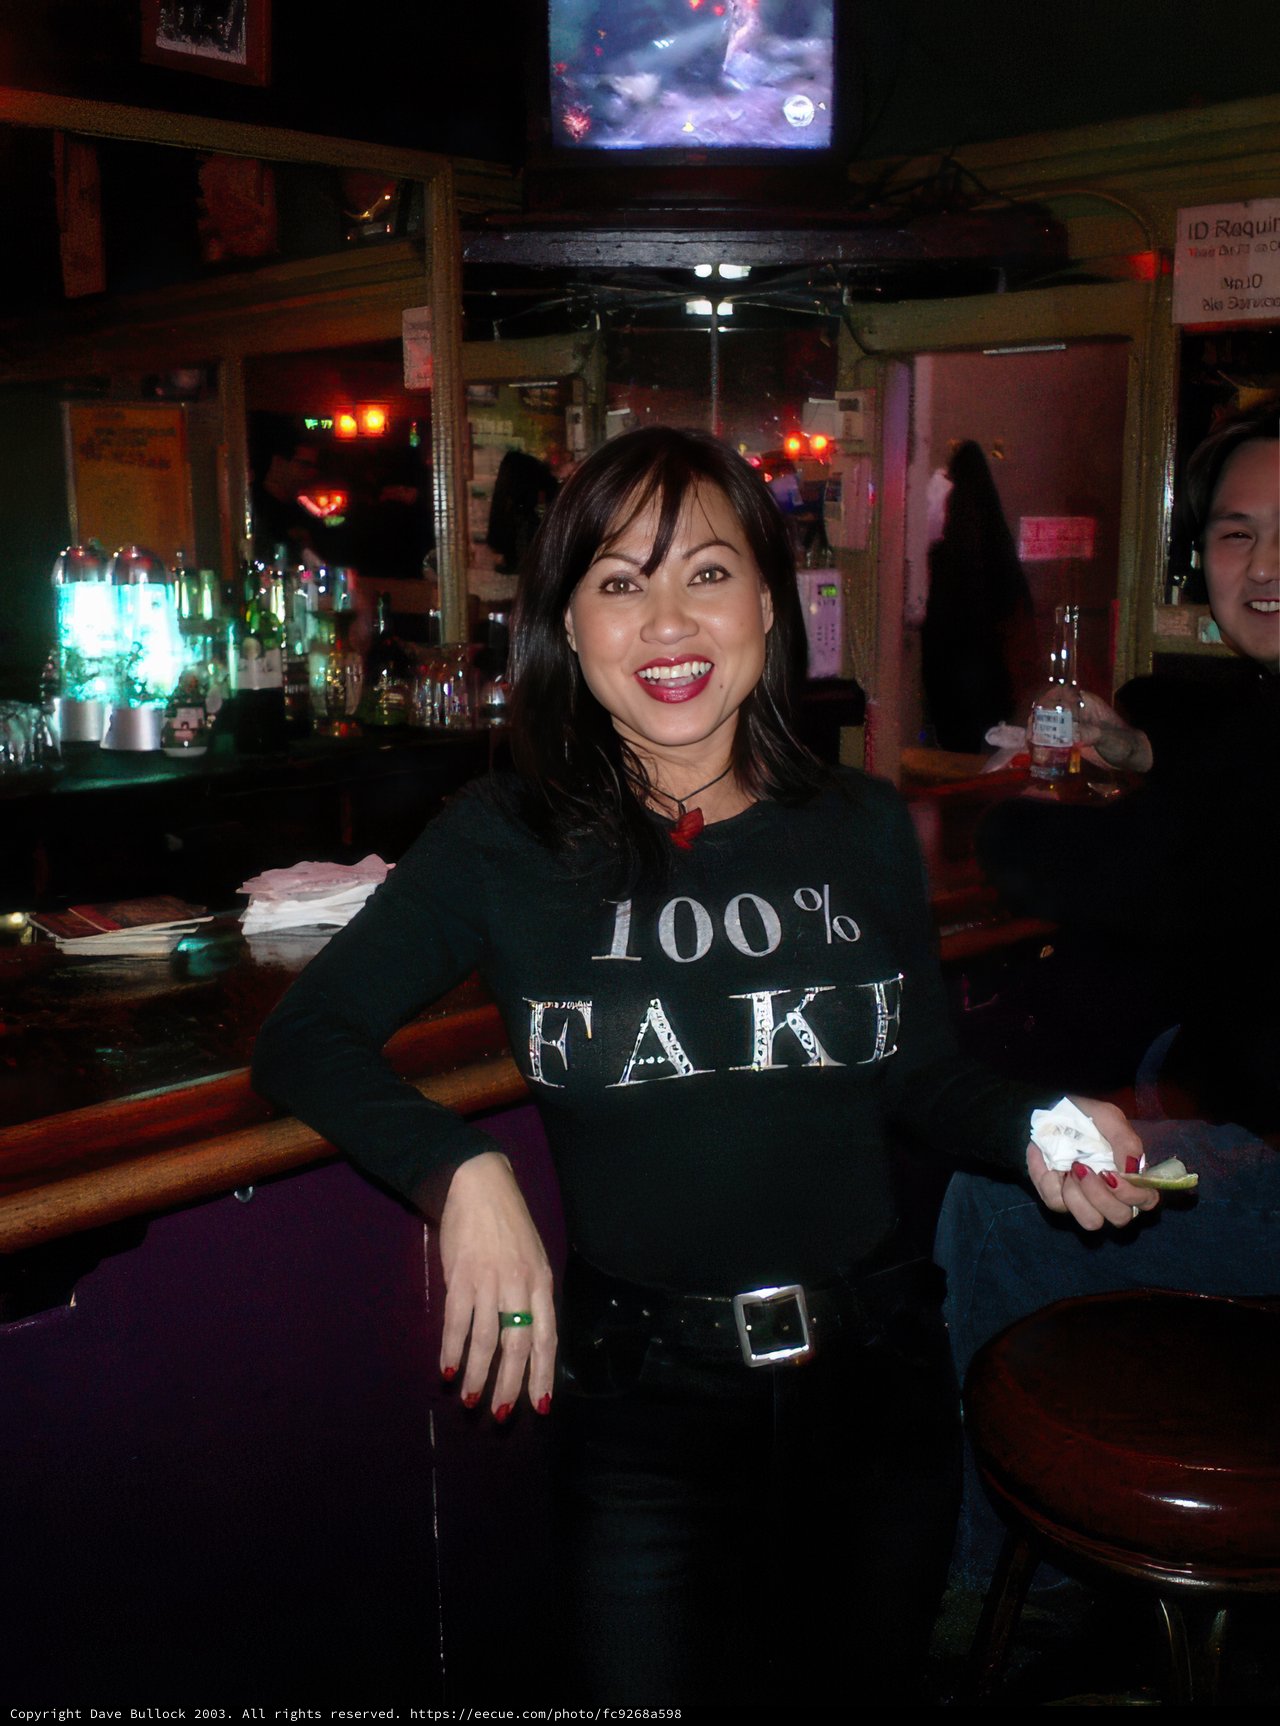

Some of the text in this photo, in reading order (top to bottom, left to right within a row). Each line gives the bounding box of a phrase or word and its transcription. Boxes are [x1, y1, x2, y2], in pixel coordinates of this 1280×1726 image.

[1188, 221, 1209, 240] ID
[592, 884, 861, 963] 100%
[522, 972, 904, 1088] FAKE
